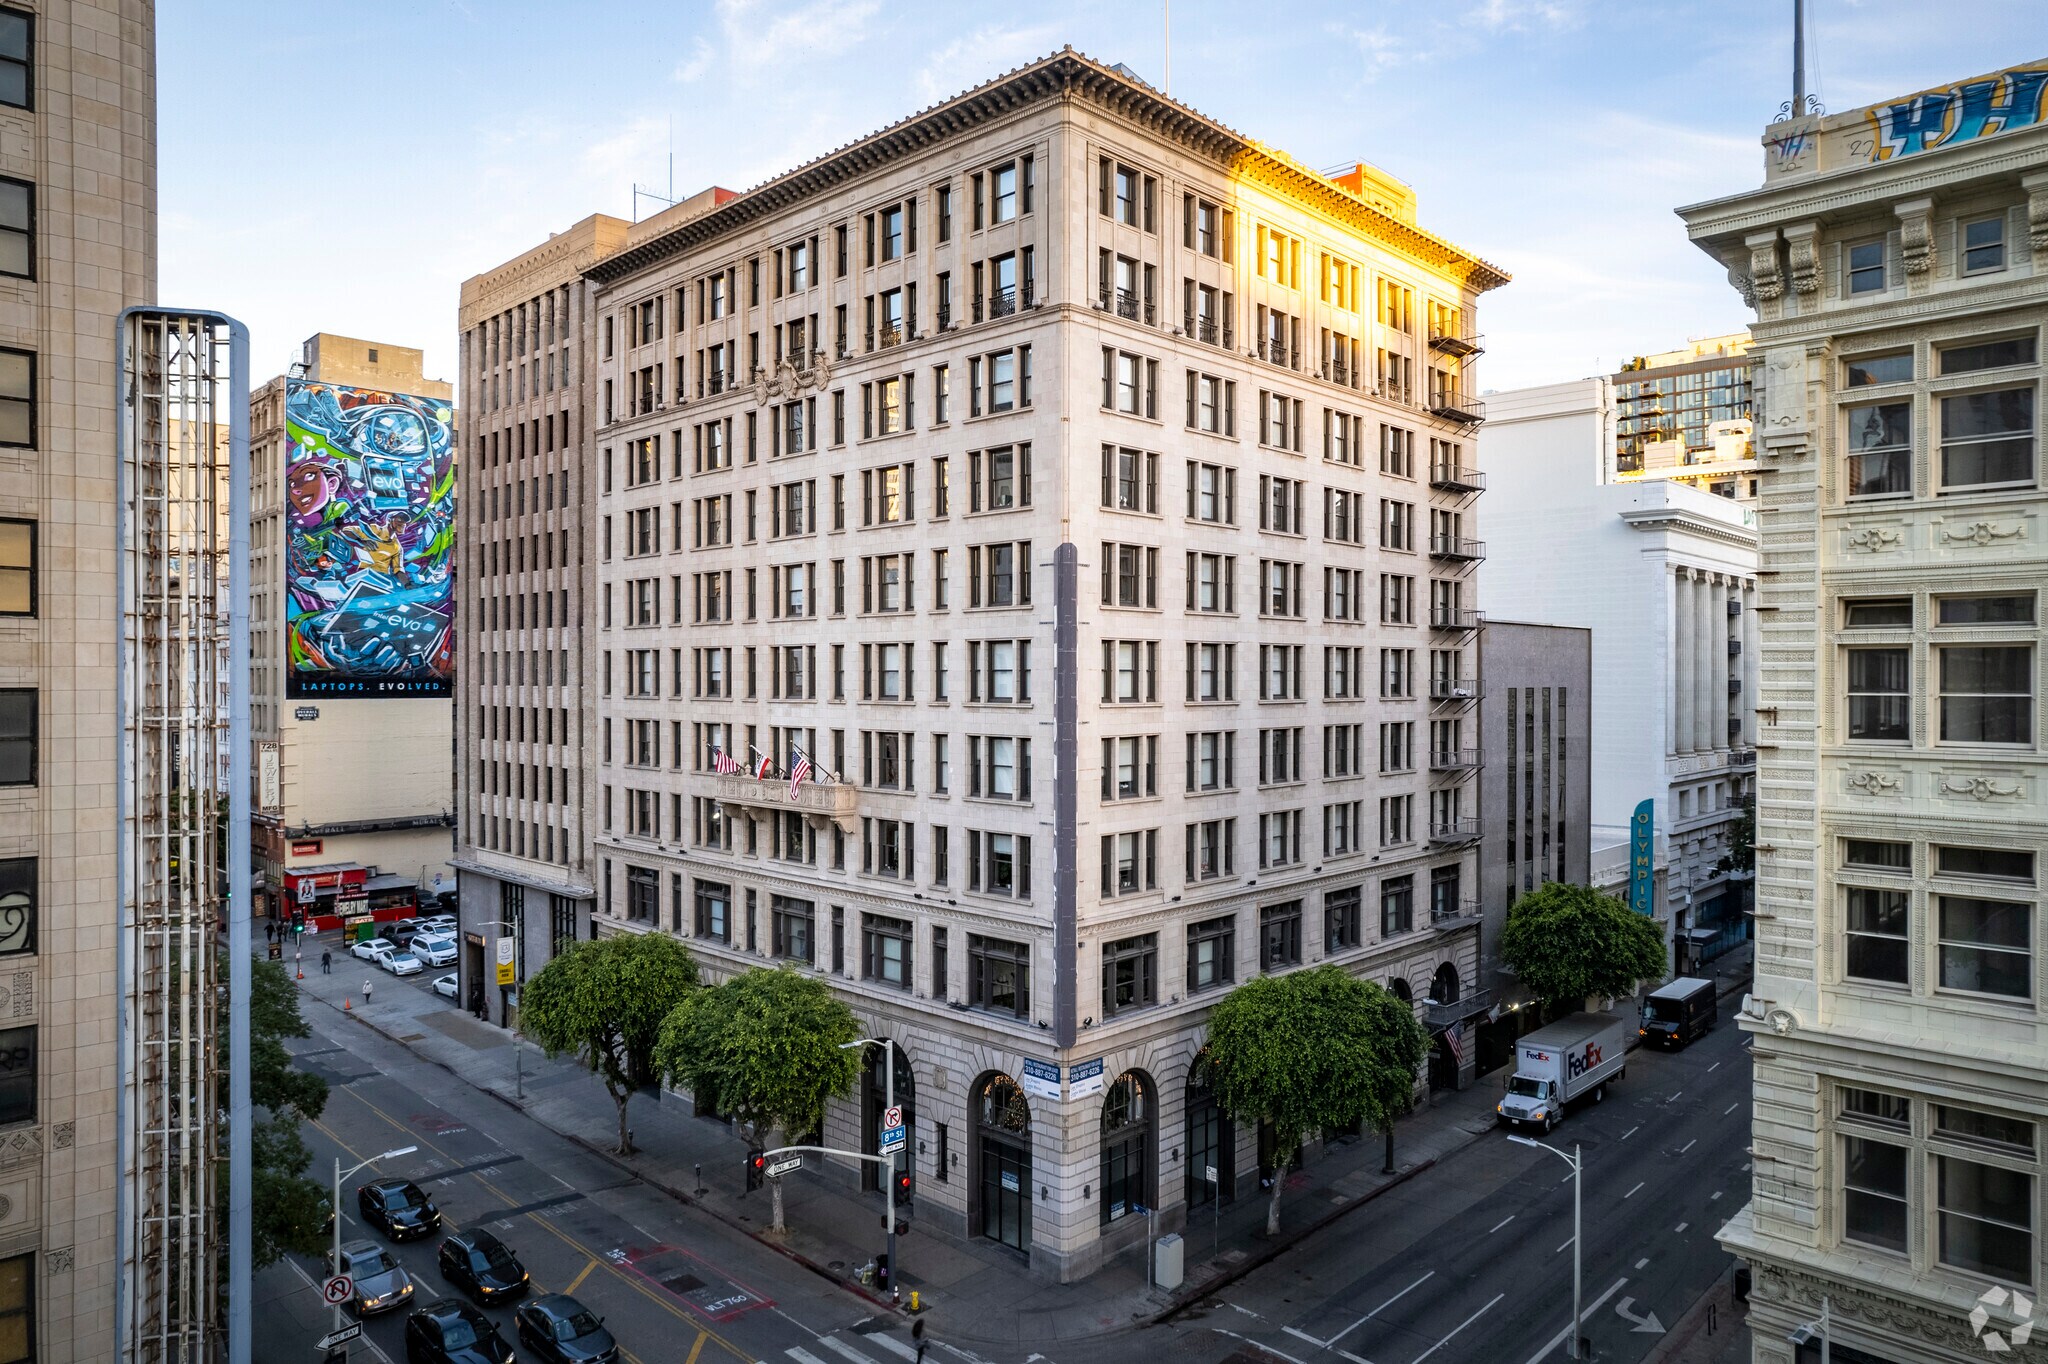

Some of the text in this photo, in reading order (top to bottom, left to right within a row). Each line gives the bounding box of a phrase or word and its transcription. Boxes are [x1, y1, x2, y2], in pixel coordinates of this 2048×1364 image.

[373, 475, 403, 489] evo
[373, 611, 421, 631] intel evo
[302, 682, 446, 691] LAPTOPS. EVOLVED.
[1636, 813, 1649, 909] OLYMPIC
[1526, 1050, 1549, 1061] FedEx
[1568, 1042, 1602, 1080] FedEx
[1025, 1066, 1057, 1081] 310-887-6226
[884, 1129, 903, 1142] 8th St
[773, 1160, 799, 1172] ONE WAY
[328, 1328, 357, 1344] ONE WAY
